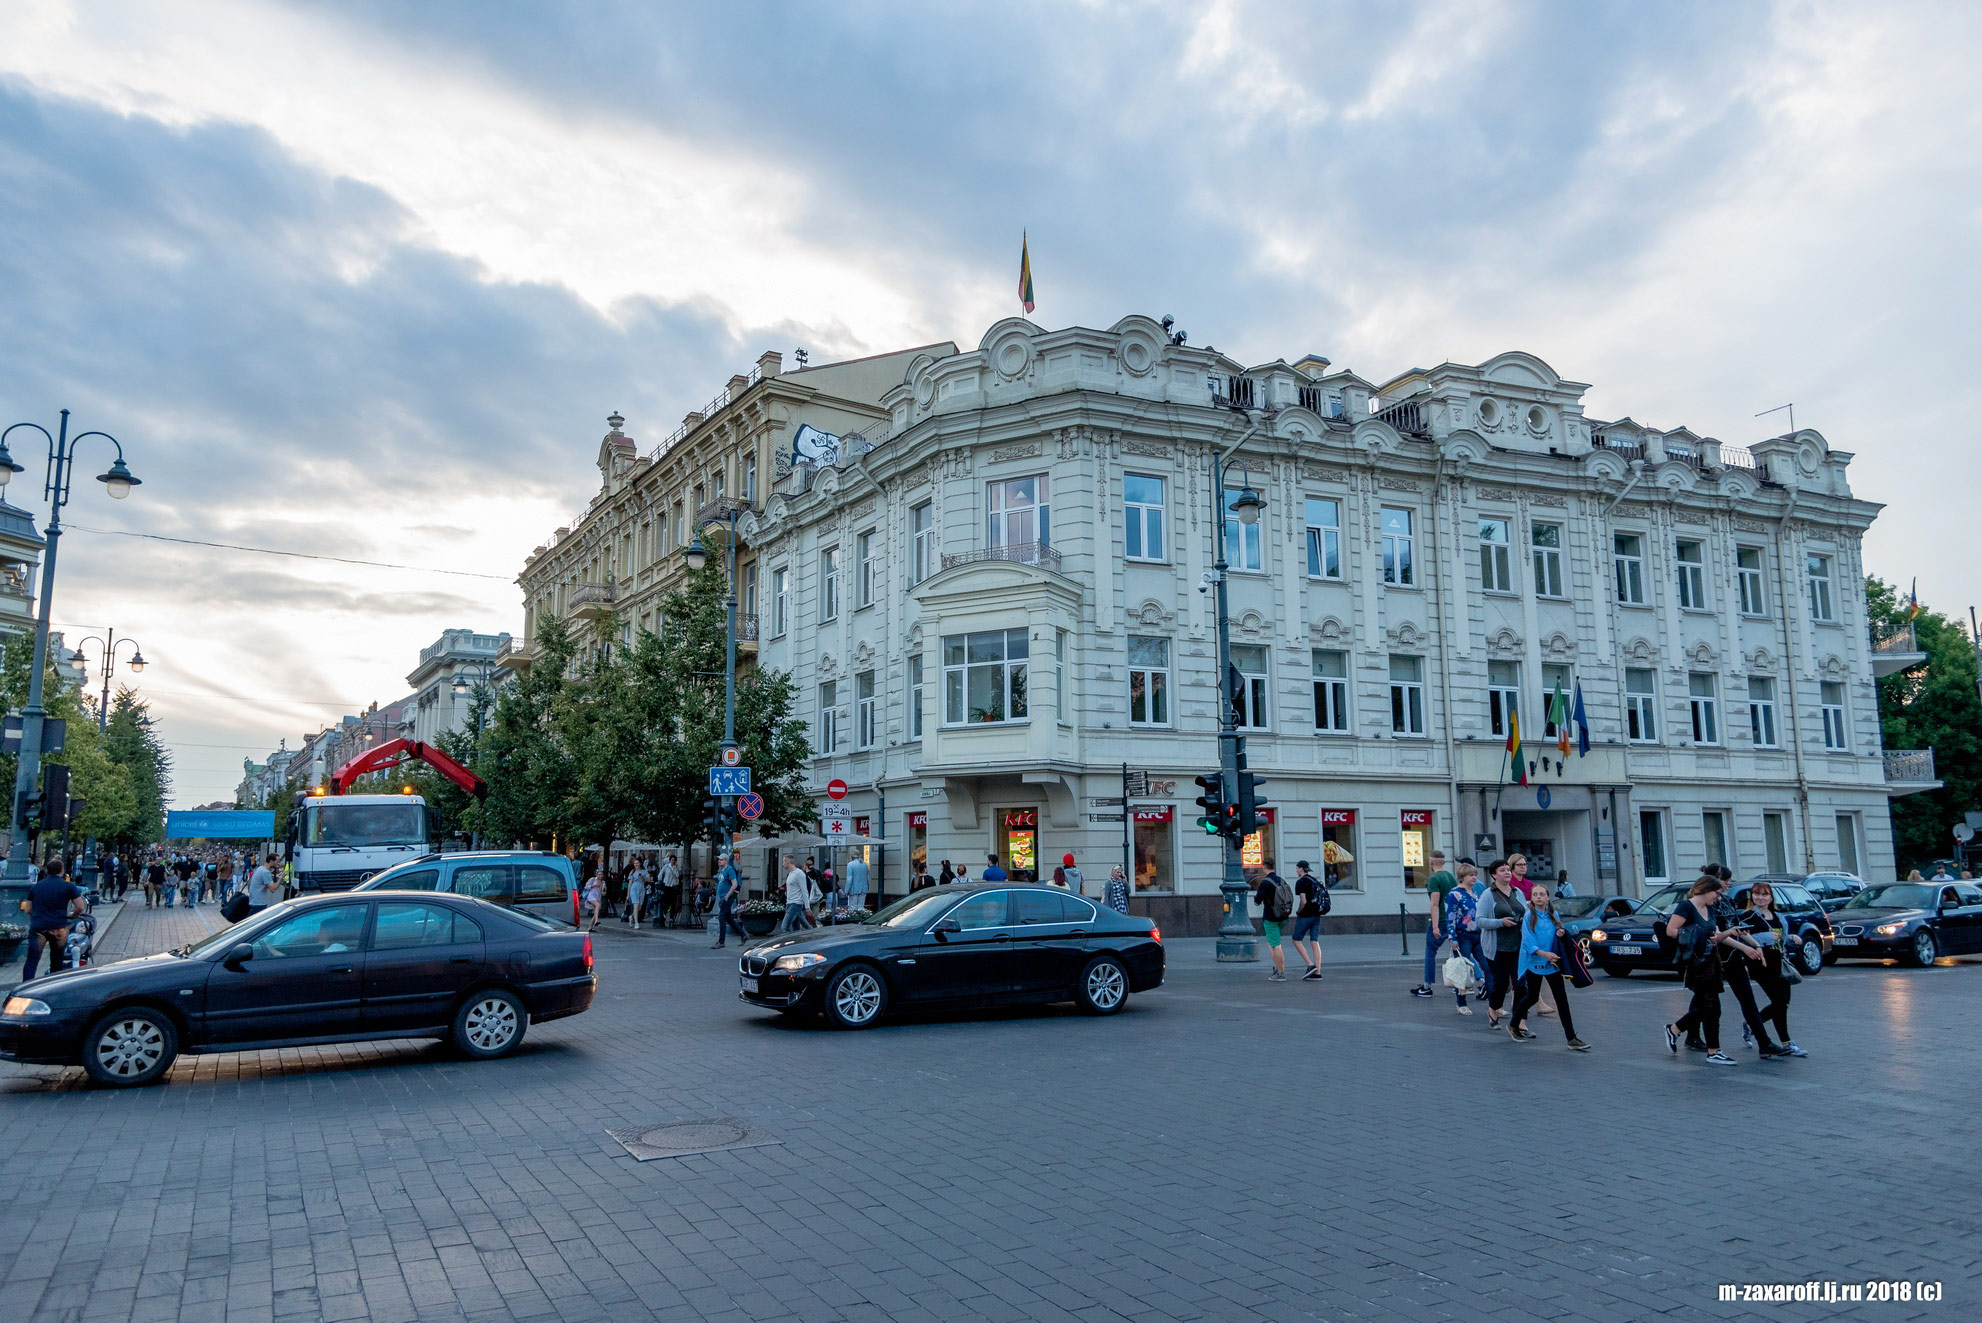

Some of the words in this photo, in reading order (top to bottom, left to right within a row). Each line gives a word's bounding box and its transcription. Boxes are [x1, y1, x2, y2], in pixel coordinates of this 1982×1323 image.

[1149, 781, 1176, 797] FC
[1005, 813, 1038, 826] KFC
[1324, 812, 1347, 822] KFC
[1403, 812, 1425, 822] KFC
[171, 820, 197, 828] unicef
[860, 819, 870, 829] KF
